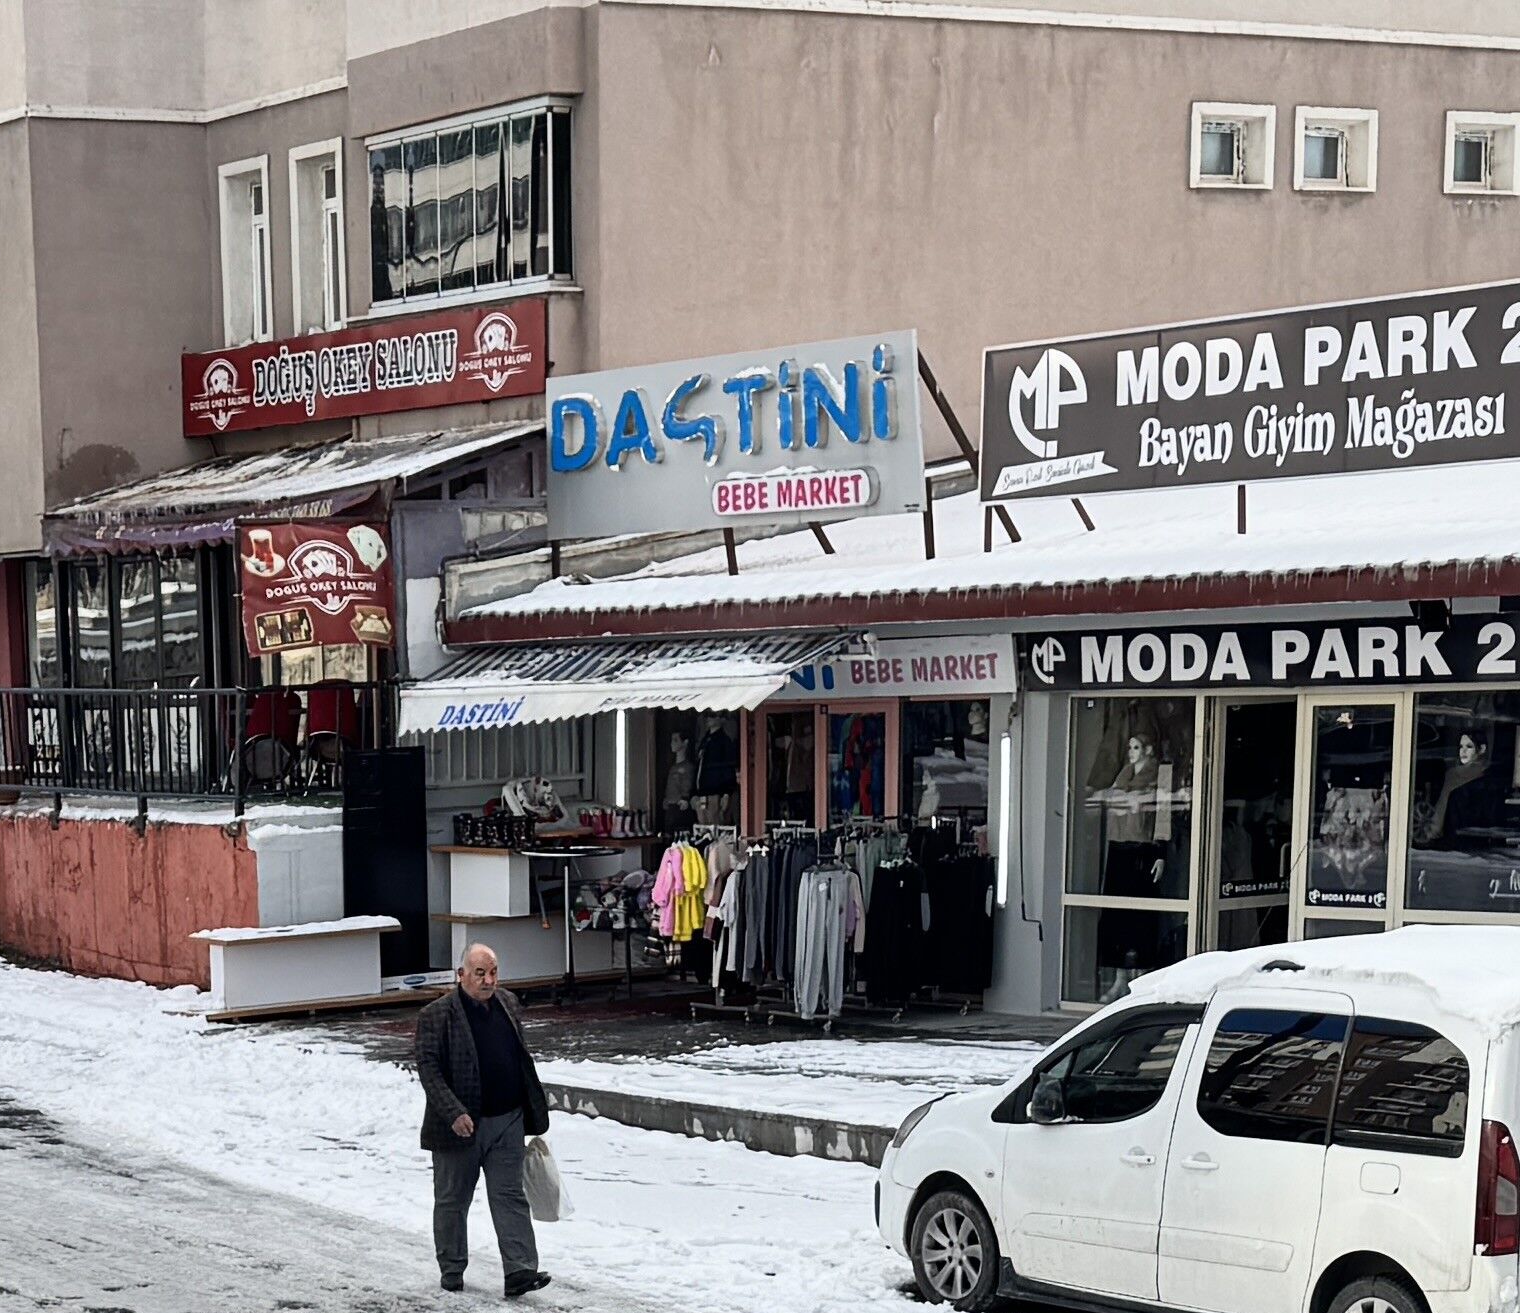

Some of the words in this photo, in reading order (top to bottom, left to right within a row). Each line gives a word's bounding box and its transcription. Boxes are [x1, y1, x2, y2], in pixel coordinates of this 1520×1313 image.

[320, 342, 373, 397] OKEY
[375, 329, 458, 390] SALONU
[1116, 332, 1283, 407] MODA
[1304, 306, 1478, 386] PARK
[1138, 416, 1233, 475] Bayan
[1243, 401, 1335, 466] Giyim
[1345, 388, 1506, 459] Mağazası
[717, 481, 769, 513] BEBE
[779, 474, 863, 508] MARKET
[850, 658, 904, 685] BEBE
[911, 652, 998, 682] MARKET
[1080, 632, 1251, 684] MODA
[1271, 625, 1453, 681] PARK
[1476, 622, 1517, 675] 2
[437, 695, 526, 725] DASTİNİ
